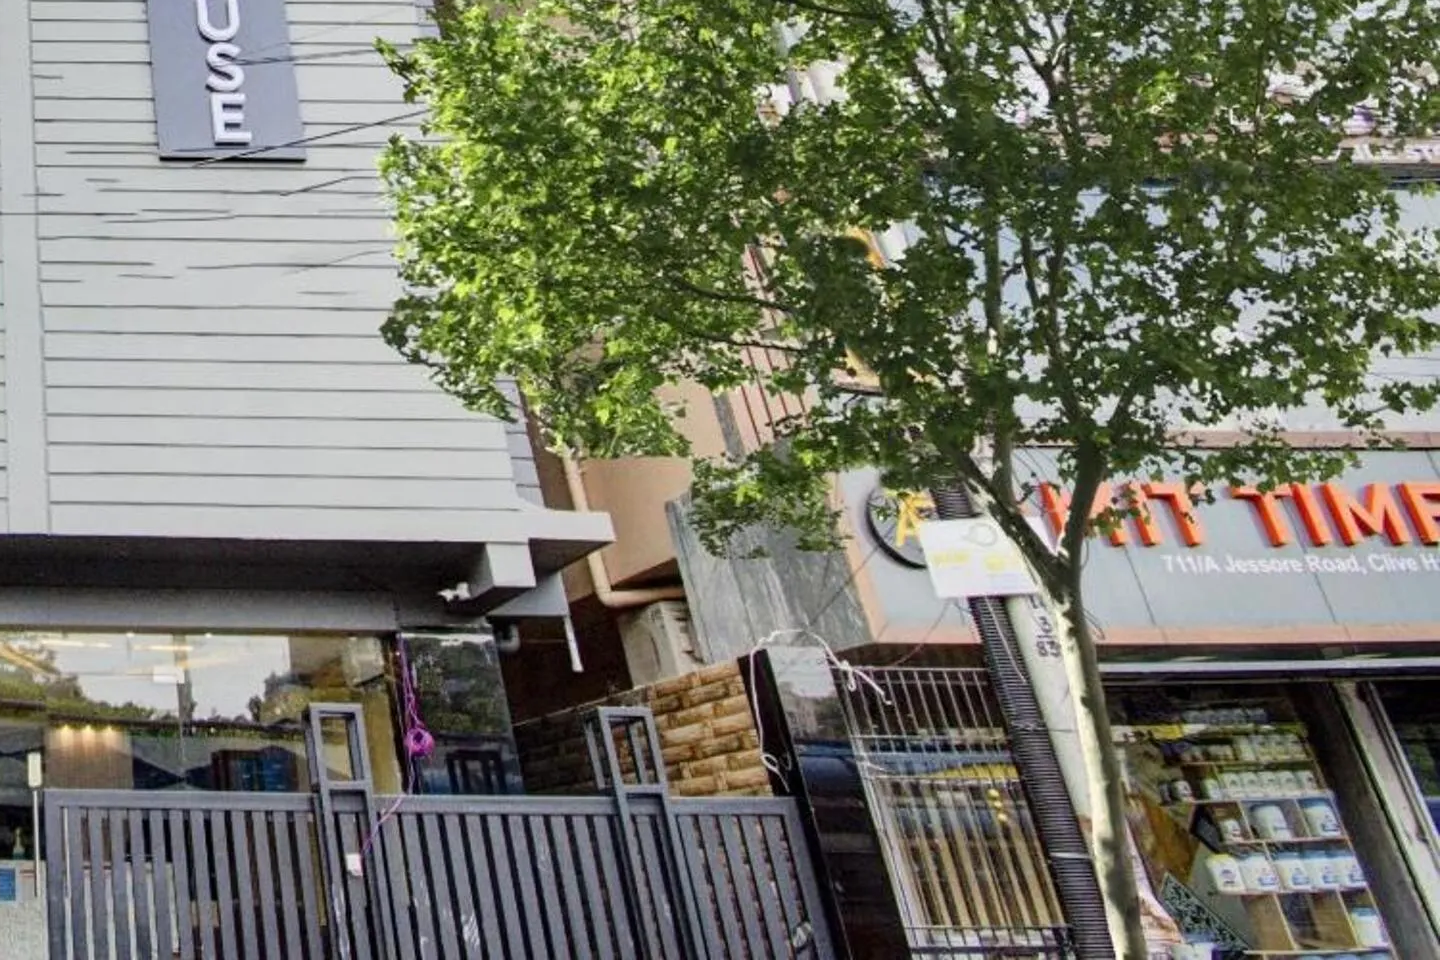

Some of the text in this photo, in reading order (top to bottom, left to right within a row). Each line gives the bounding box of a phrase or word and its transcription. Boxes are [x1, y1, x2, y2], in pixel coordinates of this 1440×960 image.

[1223, 554, 1303, 573] Jessore
[1308, 554, 1368, 575] Road,
[1368, 554, 1418, 573] Clive
[1422, 554, 1440, 572] H
